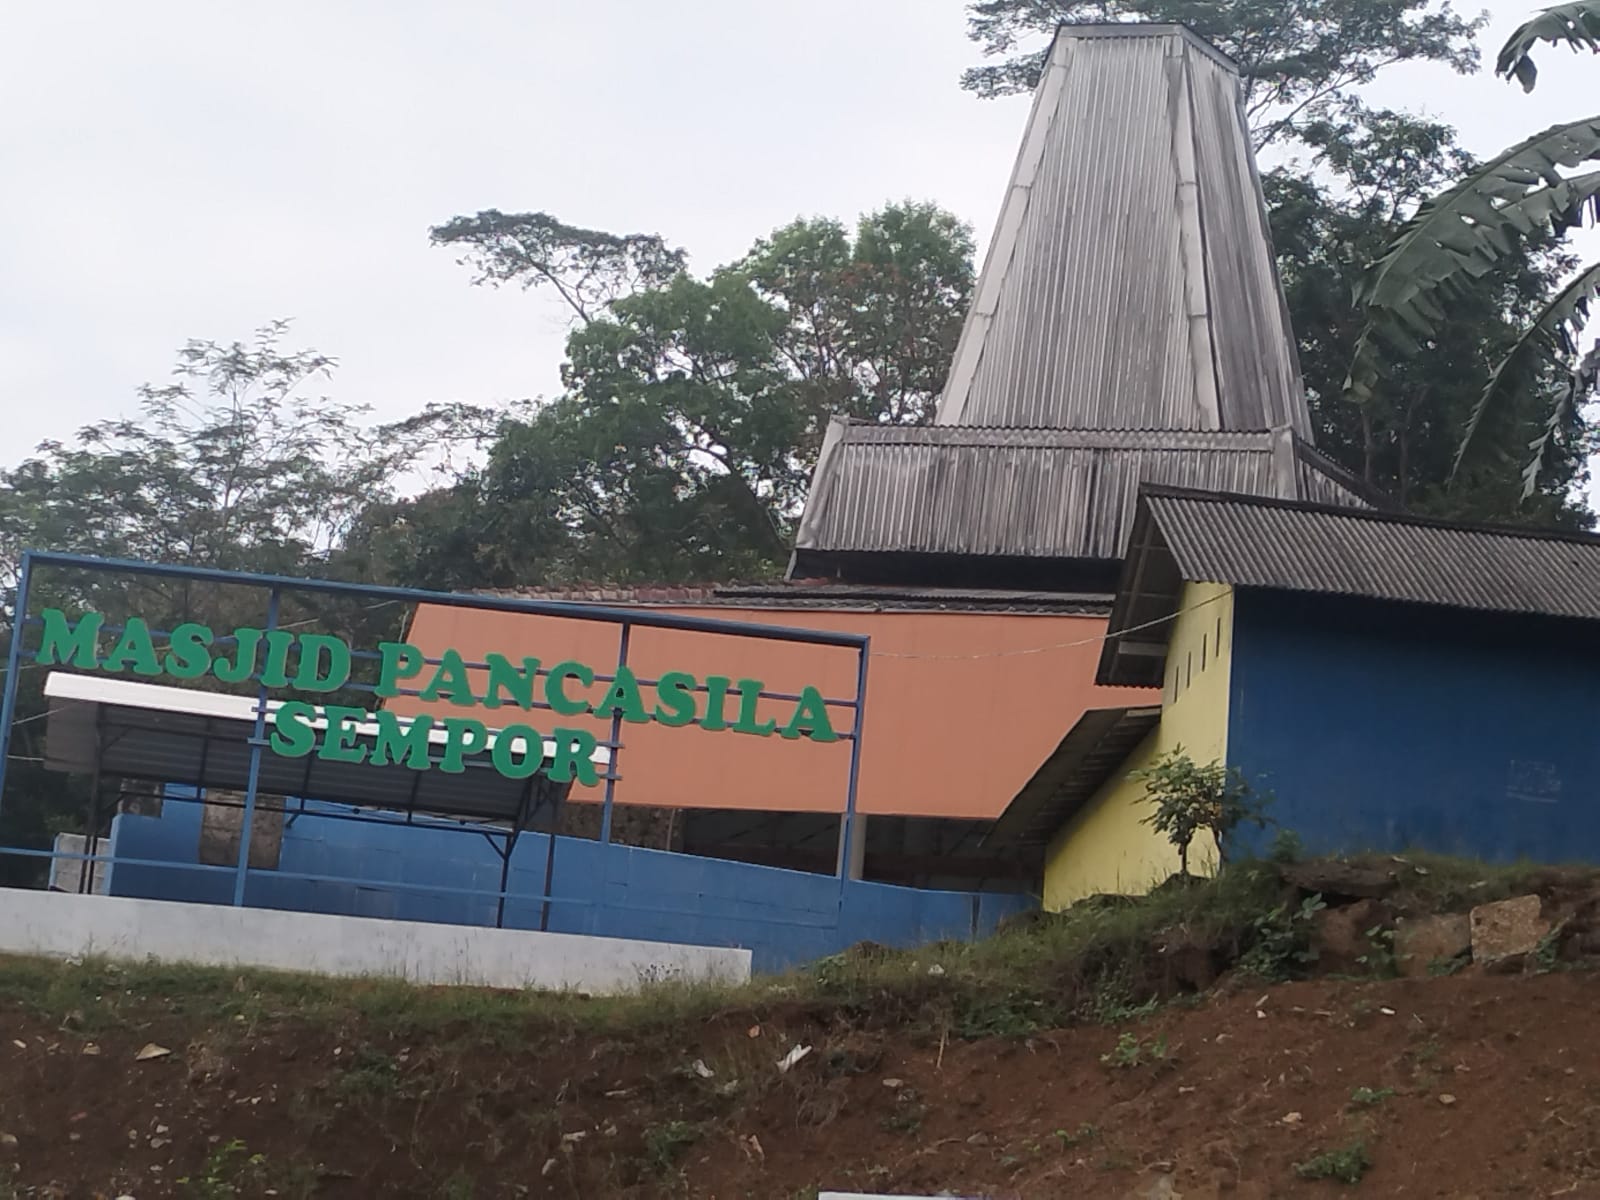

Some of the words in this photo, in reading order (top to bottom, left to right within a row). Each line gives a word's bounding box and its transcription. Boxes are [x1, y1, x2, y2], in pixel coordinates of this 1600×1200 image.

[35, 608, 352, 693] MASJID
[375, 642, 839, 742] PANCASILA
[269, 701, 600, 786] SEMPOR
